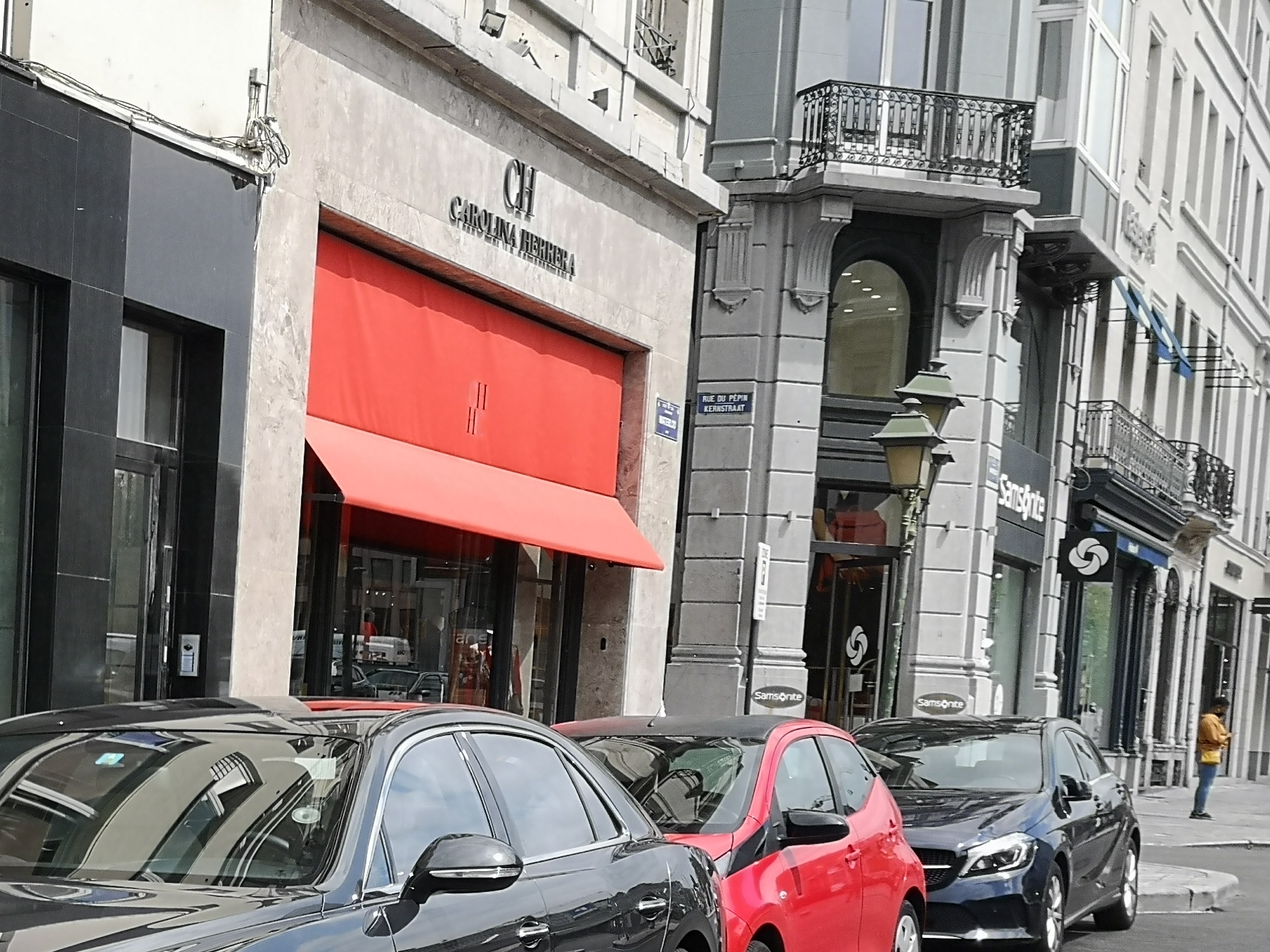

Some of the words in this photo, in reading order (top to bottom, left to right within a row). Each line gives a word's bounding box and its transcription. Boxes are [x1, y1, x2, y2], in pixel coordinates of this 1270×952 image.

[502, 158, 538, 220] CH
[448, 195, 518, 251] CAROLINA
[519, 228, 576, 279] HERRERA
[702, 395, 715, 403] RUE
[717, 395, 727, 403] DU
[728, 393, 749, 403] PÉPIN
[703, 404, 746, 413] KERNSTRAAT
[998, 473, 1045, 522] Samsonite
[754, 691, 803, 702] Samsonite
[917, 698, 965, 709] Samsonite
